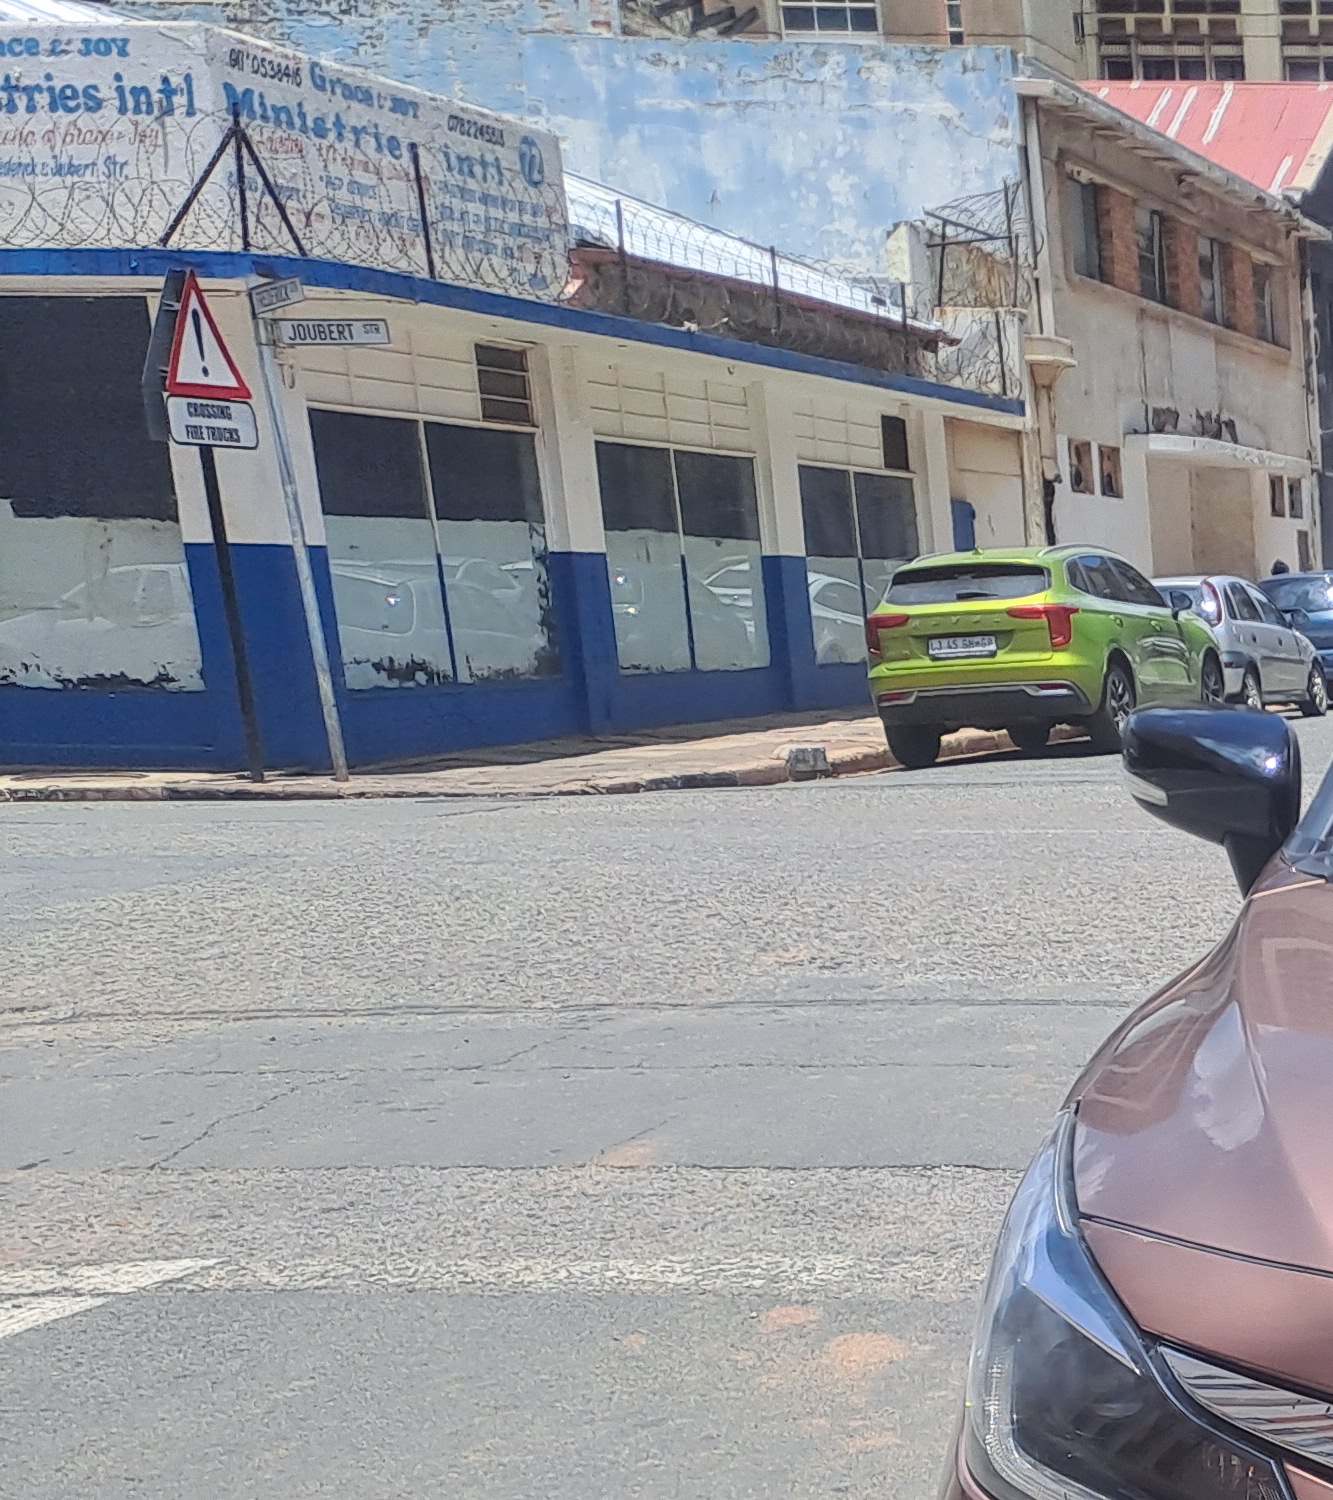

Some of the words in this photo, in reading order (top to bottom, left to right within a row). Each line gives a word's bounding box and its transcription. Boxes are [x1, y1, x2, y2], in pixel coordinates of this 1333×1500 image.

[0, 72, 103, 114] tries
[288, 323, 354, 342] JOUBERT
[186, 401, 233, 421] CROSSING
[205, 426, 242, 444] TRUCKS
